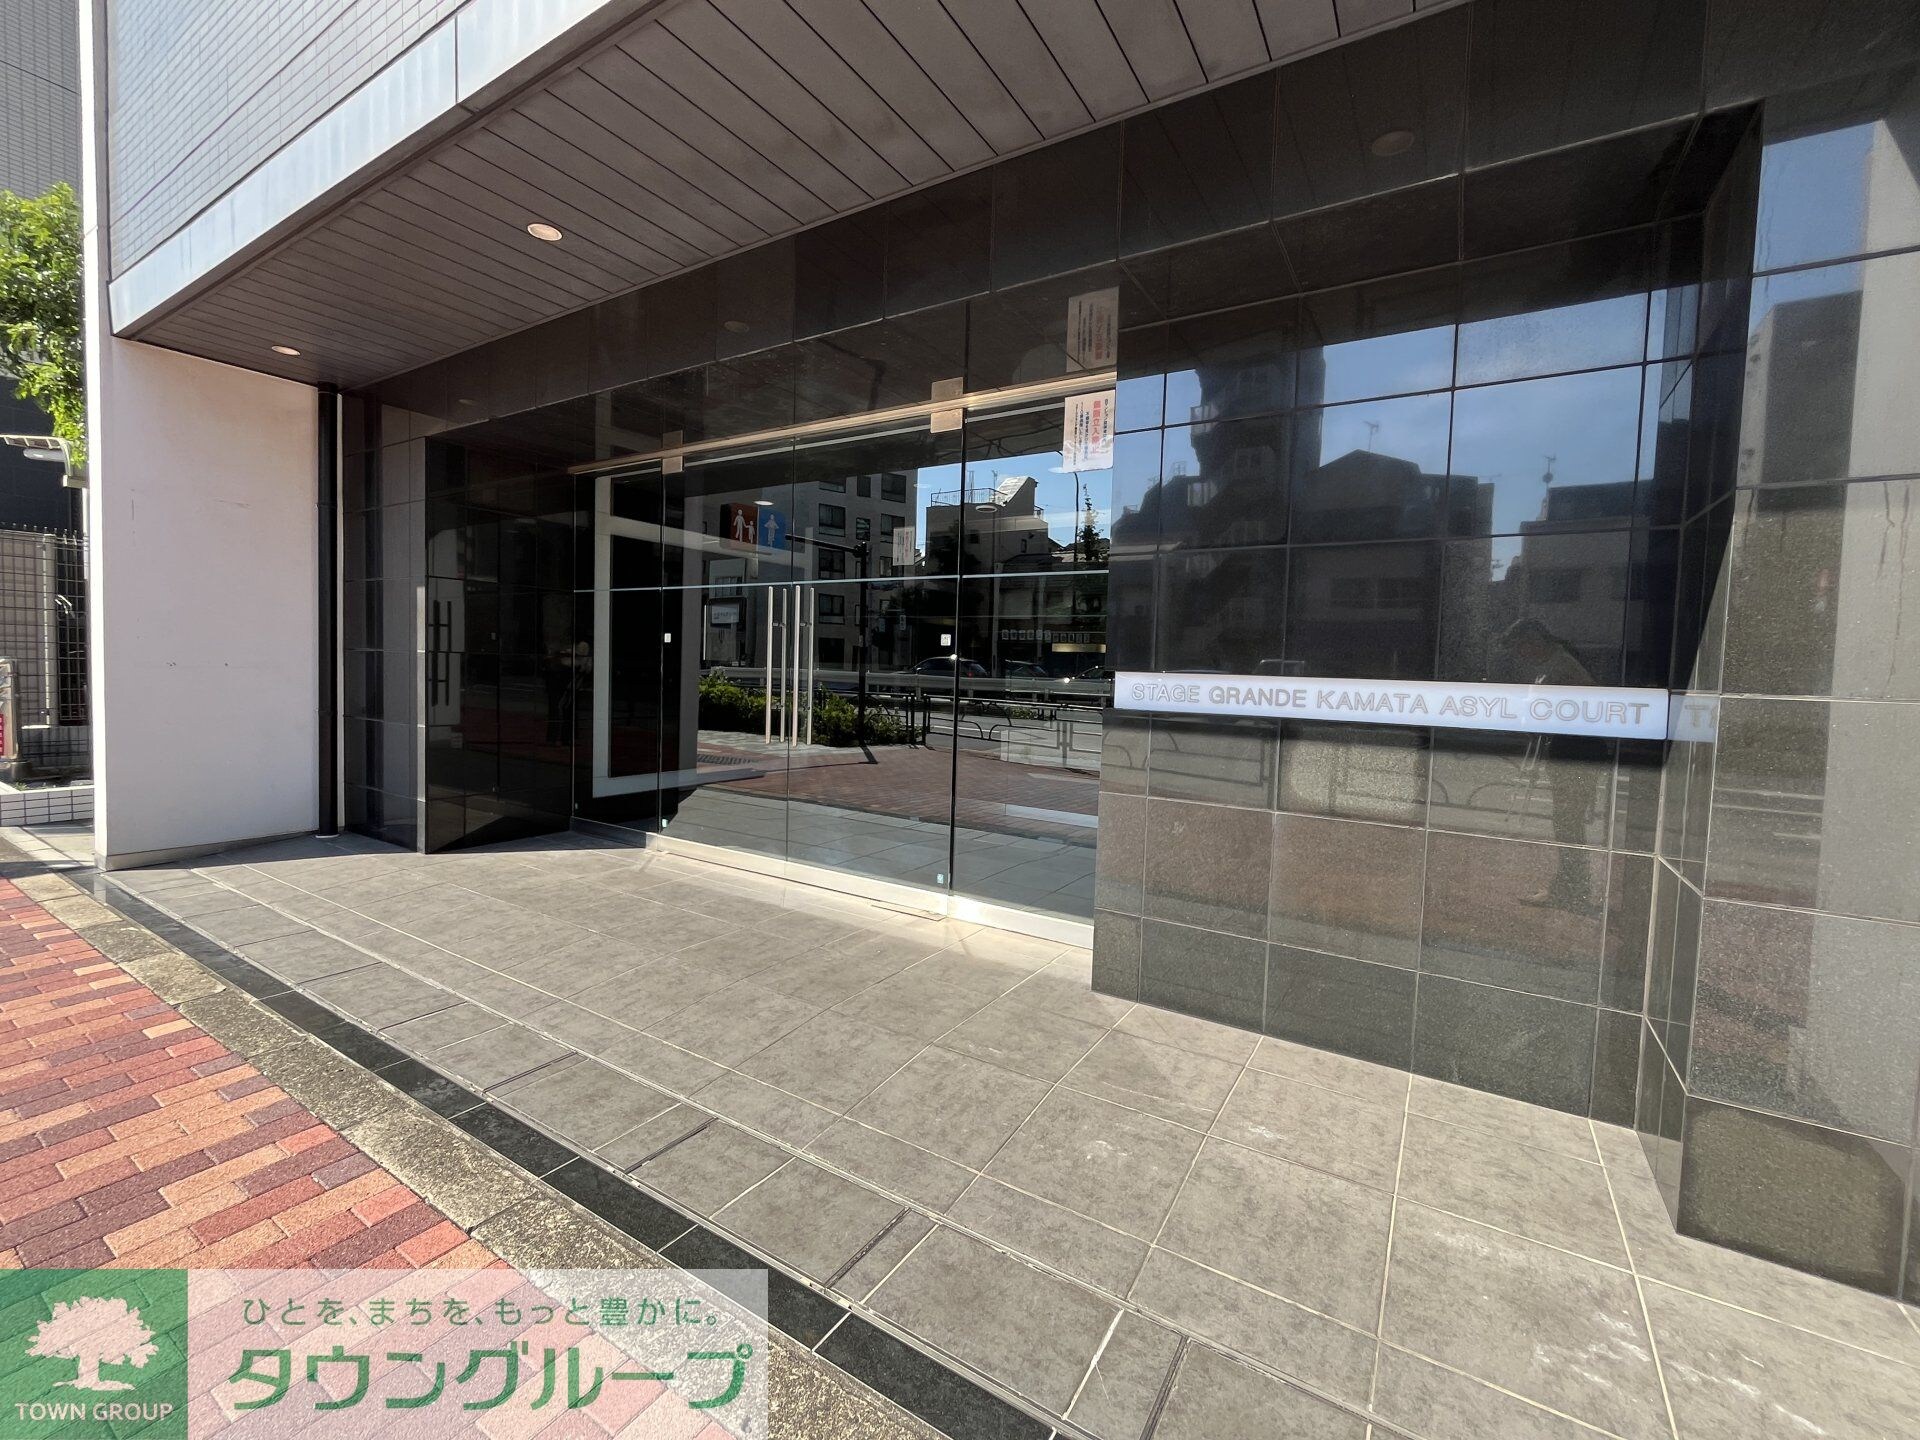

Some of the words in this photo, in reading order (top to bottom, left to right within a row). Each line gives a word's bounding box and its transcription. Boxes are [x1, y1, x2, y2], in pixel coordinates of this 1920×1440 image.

[1131, 682, 1200, 703] STAGE
[1209, 687, 1307, 708] GRANDE
[1317, 691, 1428, 714] KAMATA
[1440, 696, 1517, 719] ASYL
[1529, 698, 1649, 724] COURT
